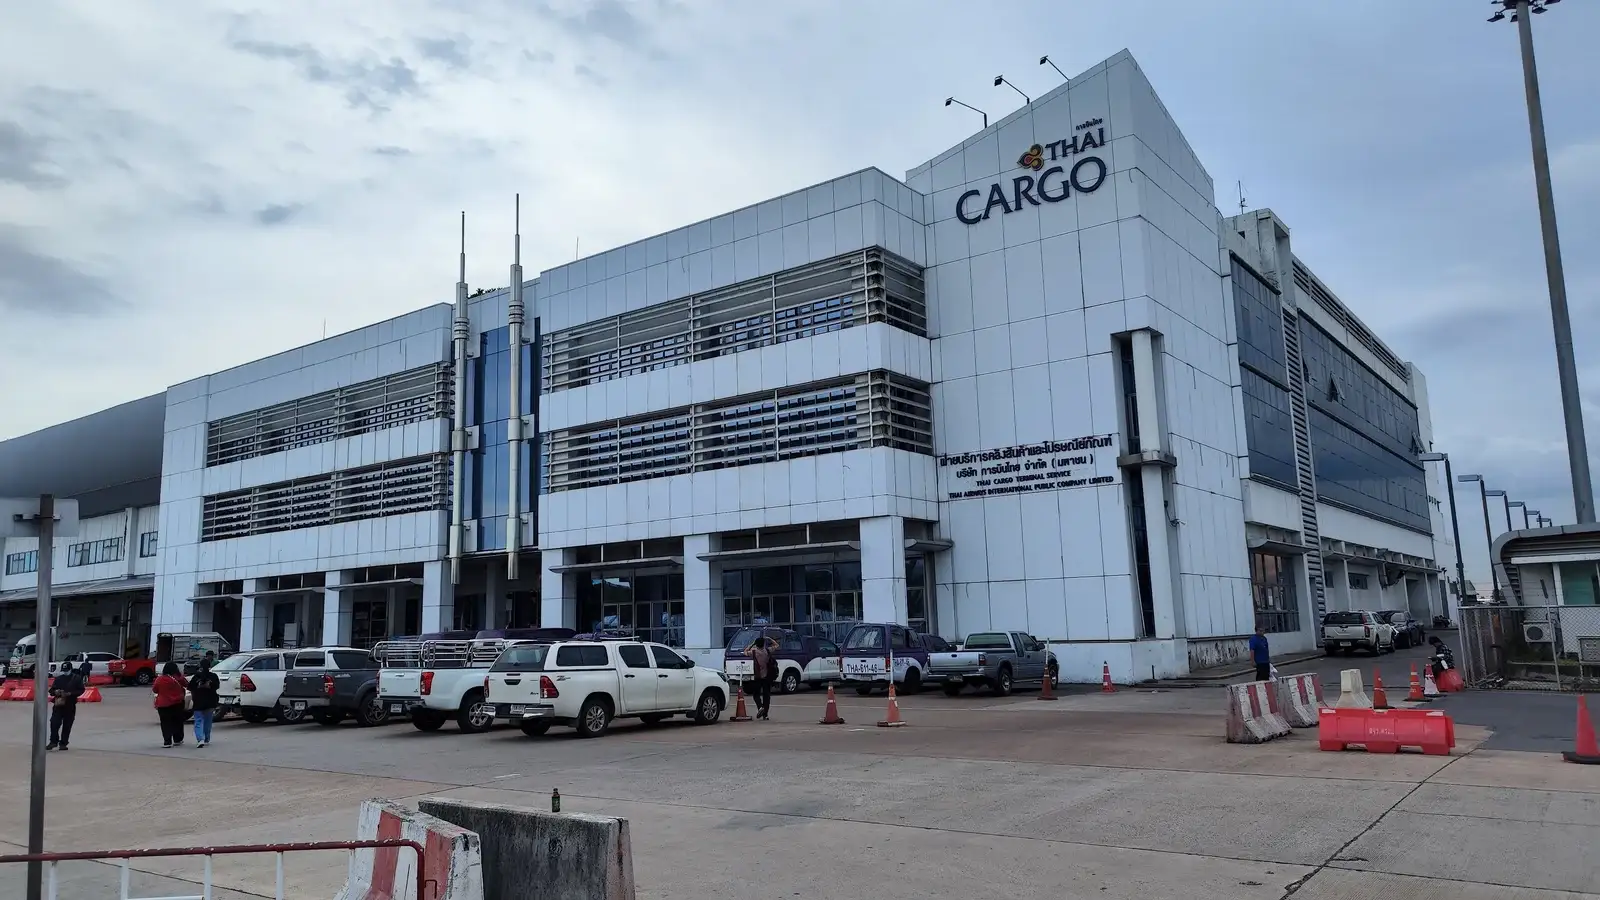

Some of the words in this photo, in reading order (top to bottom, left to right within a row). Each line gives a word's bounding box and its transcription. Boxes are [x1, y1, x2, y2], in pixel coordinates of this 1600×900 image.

[1045, 127, 1106, 161] THAI
[956, 156, 1107, 225] CARGO
[956, 467, 978, 479] บริษัท
[981, 461, 1021, 476] การบินไทย
[1024, 459, 1047, 471] จำกัด
[993, 477, 1014, 485] CARGO
[1016, 473, 1045, 482] TERMINAL
[1046, 470, 1071, 479] SERVICE
[964, 489, 987, 498] AIRWAYS
[988, 484, 1033, 495] INTERNATIONAL
[1034, 482, 1056, 490] PUBLIC
[1057, 479, 1087, 488] COMPANY
[1089, 476, 1114, 485] LIMITED
